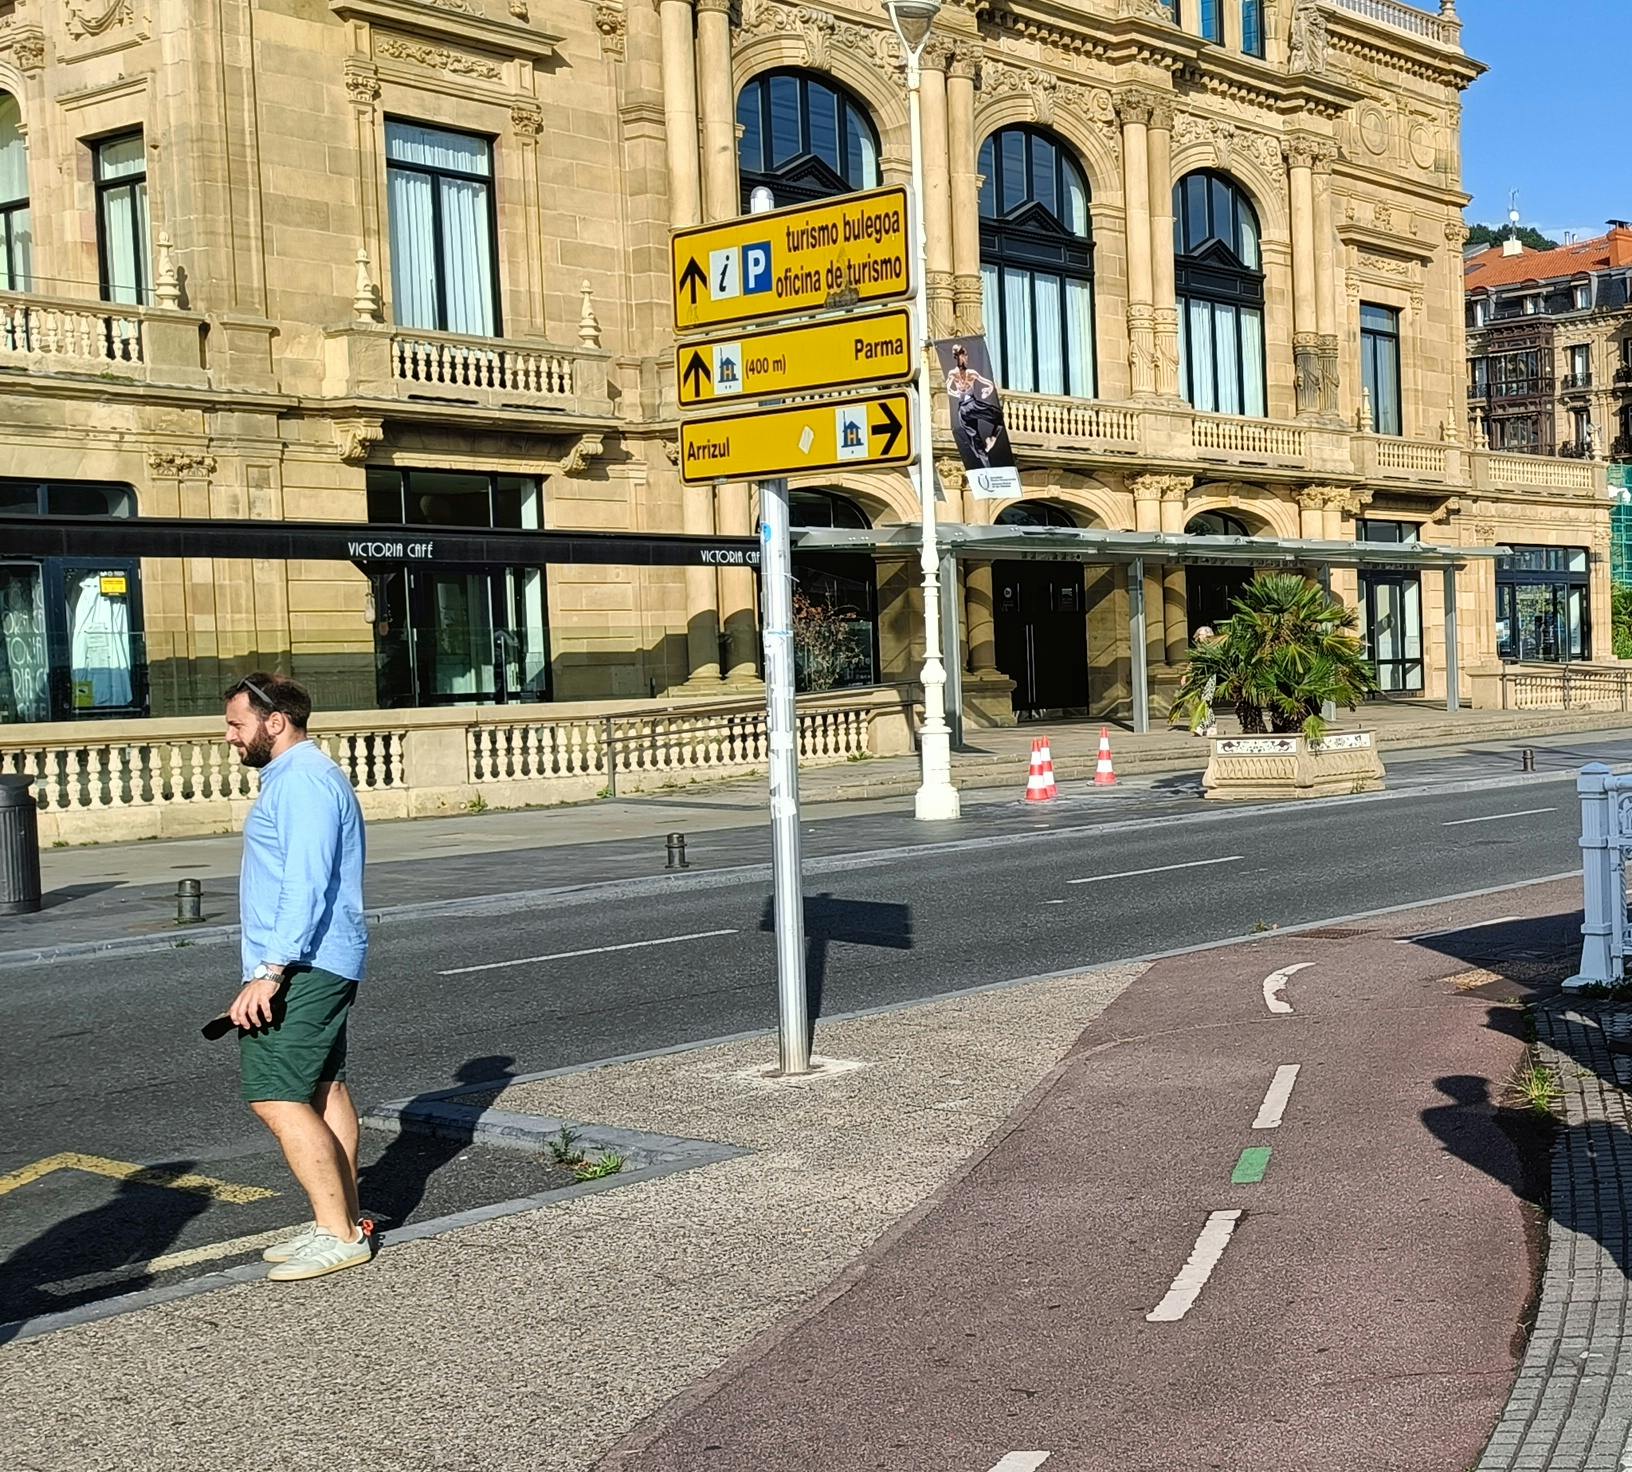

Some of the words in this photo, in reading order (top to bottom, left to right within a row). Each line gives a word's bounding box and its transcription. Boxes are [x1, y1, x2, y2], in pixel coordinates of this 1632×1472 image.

[786, 221, 839, 254] turismo
[843, 209, 901, 245] bulegoa
[776, 267, 821, 298] oficina
[825, 264, 843, 290] de
[848, 252, 901, 286] turismo
[854, 337, 904, 361] Parma
[745, 360, 769, 379] (400
[772, 353, 787, 374] m)
[687, 436, 730, 462] Arrizul
[348, 541, 403, 558] VICTORIA
[407, 541, 434, 558] CAFÉ
[700, 550, 743, 563] VICTORIA
[745, 551, 760, 564] CAF
